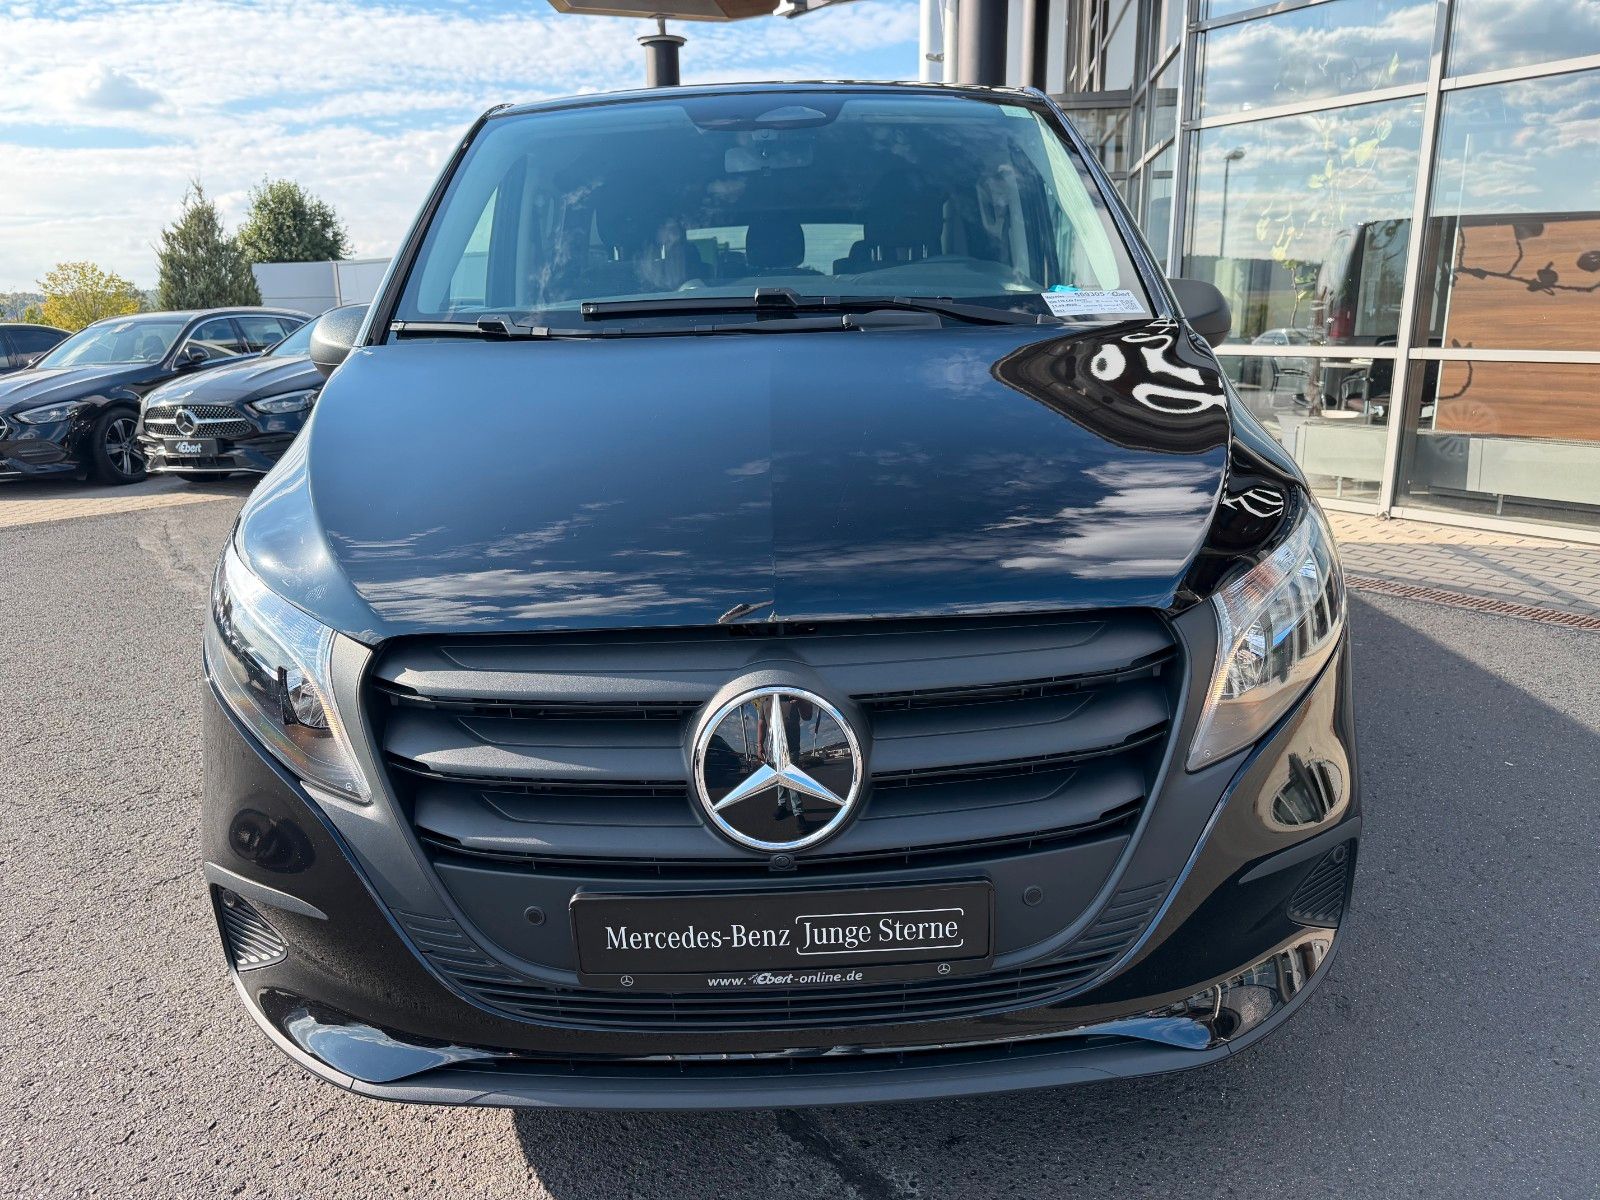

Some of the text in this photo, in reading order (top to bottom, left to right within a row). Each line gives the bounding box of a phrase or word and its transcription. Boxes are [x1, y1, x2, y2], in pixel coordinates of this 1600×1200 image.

[605, 918, 958, 950] Mercedes-Benz Junge Sterne
